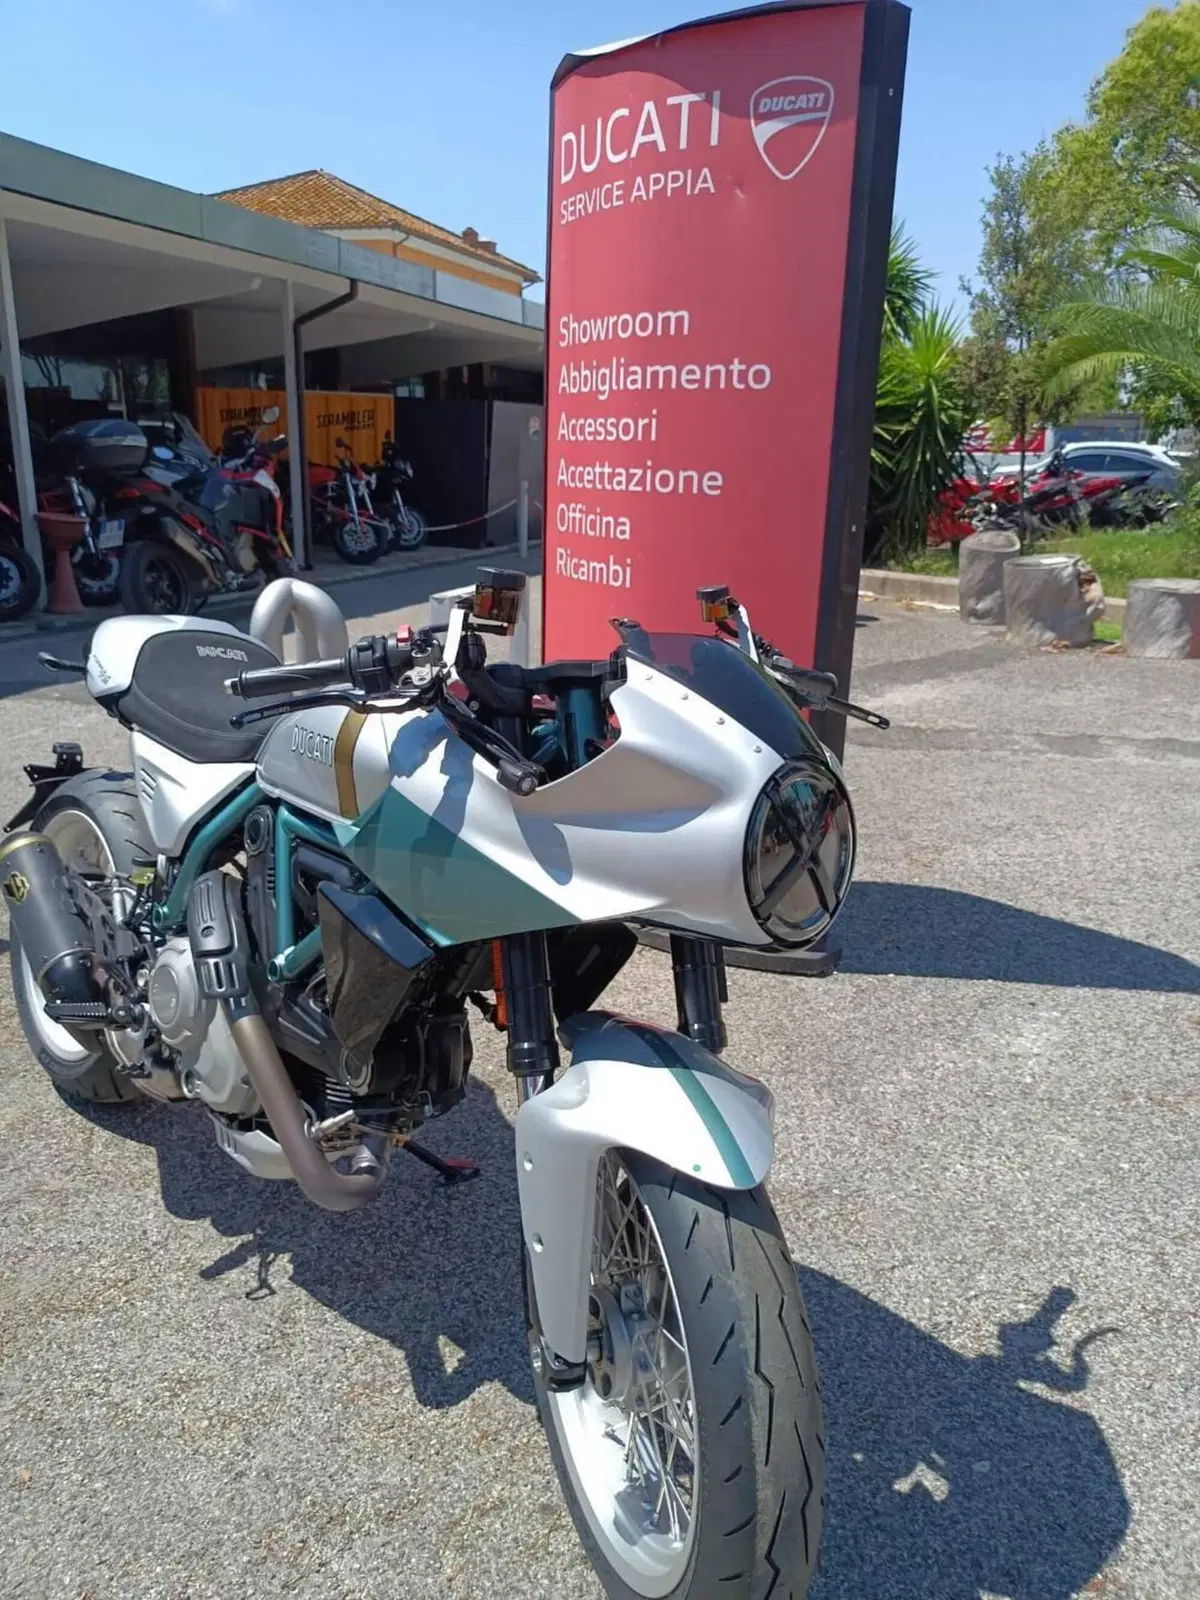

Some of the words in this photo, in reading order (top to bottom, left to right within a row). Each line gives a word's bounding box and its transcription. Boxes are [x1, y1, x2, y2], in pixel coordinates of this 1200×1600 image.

[759, 92, 825, 113] DUCATI
[560, 90, 720, 184] DUCATI
[560, 180, 625, 225] SERVICE
[630, 167, 715, 203] APPIA
[559, 310, 690, 347] Showroom
[558, 357, 771, 400] Abbigliamento
[315, 409, 376, 429] SCRAMBLER
[557, 409, 658, 442] Accessori
[556, 457, 724, 496] Accettazione
[556, 503, 631, 540] Officina
[556, 547, 632, 588] Ricambi
[196, 645, 249, 662] DUCATI
[291, 724, 335, 767] DUCATI
